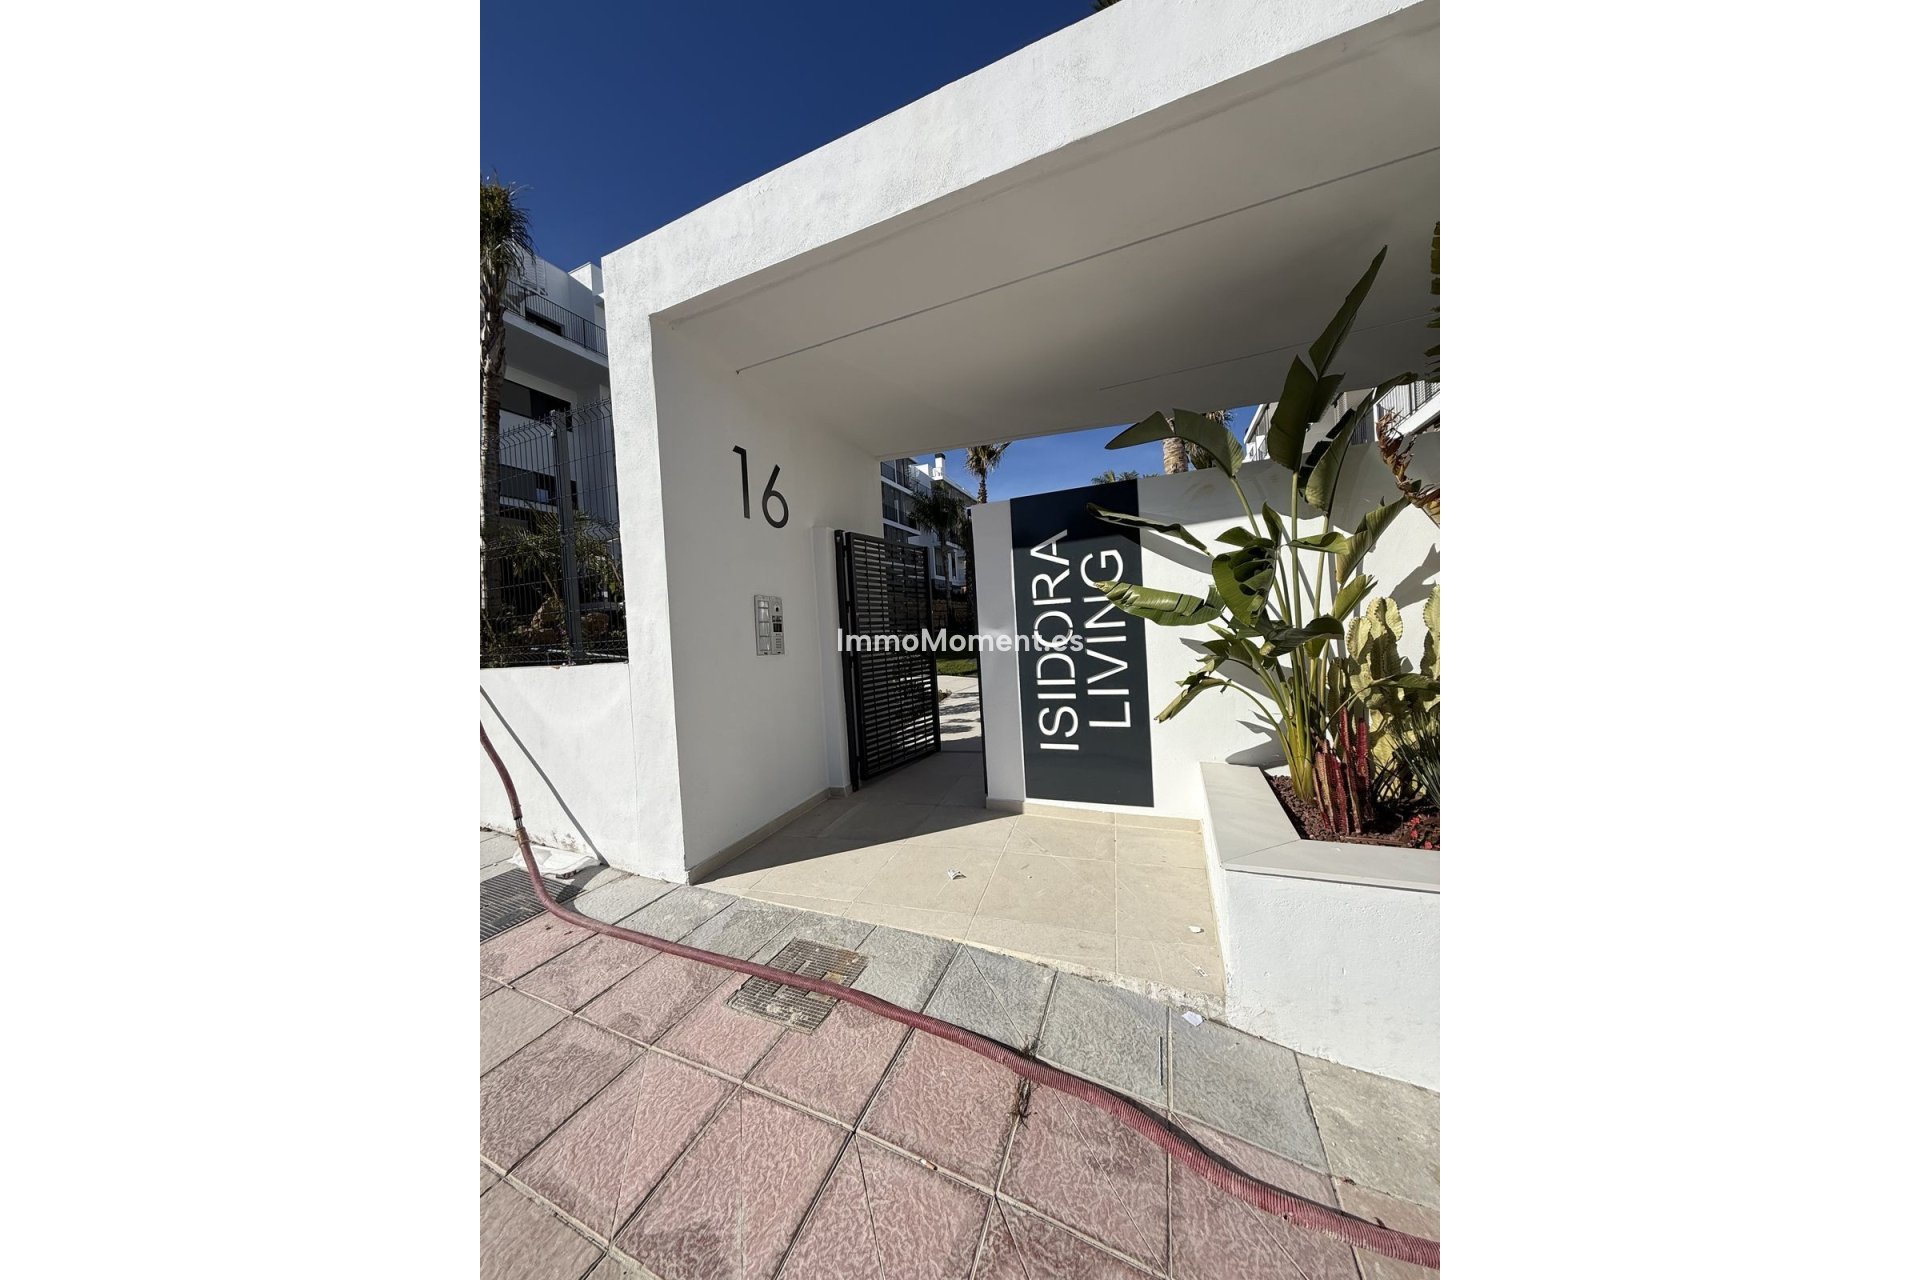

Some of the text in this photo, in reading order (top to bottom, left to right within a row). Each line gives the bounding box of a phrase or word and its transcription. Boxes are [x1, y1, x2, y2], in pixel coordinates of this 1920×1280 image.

[732, 445, 789, 528] 16
[1030, 529, 1080, 750] ISIDORA
[1080, 549, 1132, 728] LIVING
